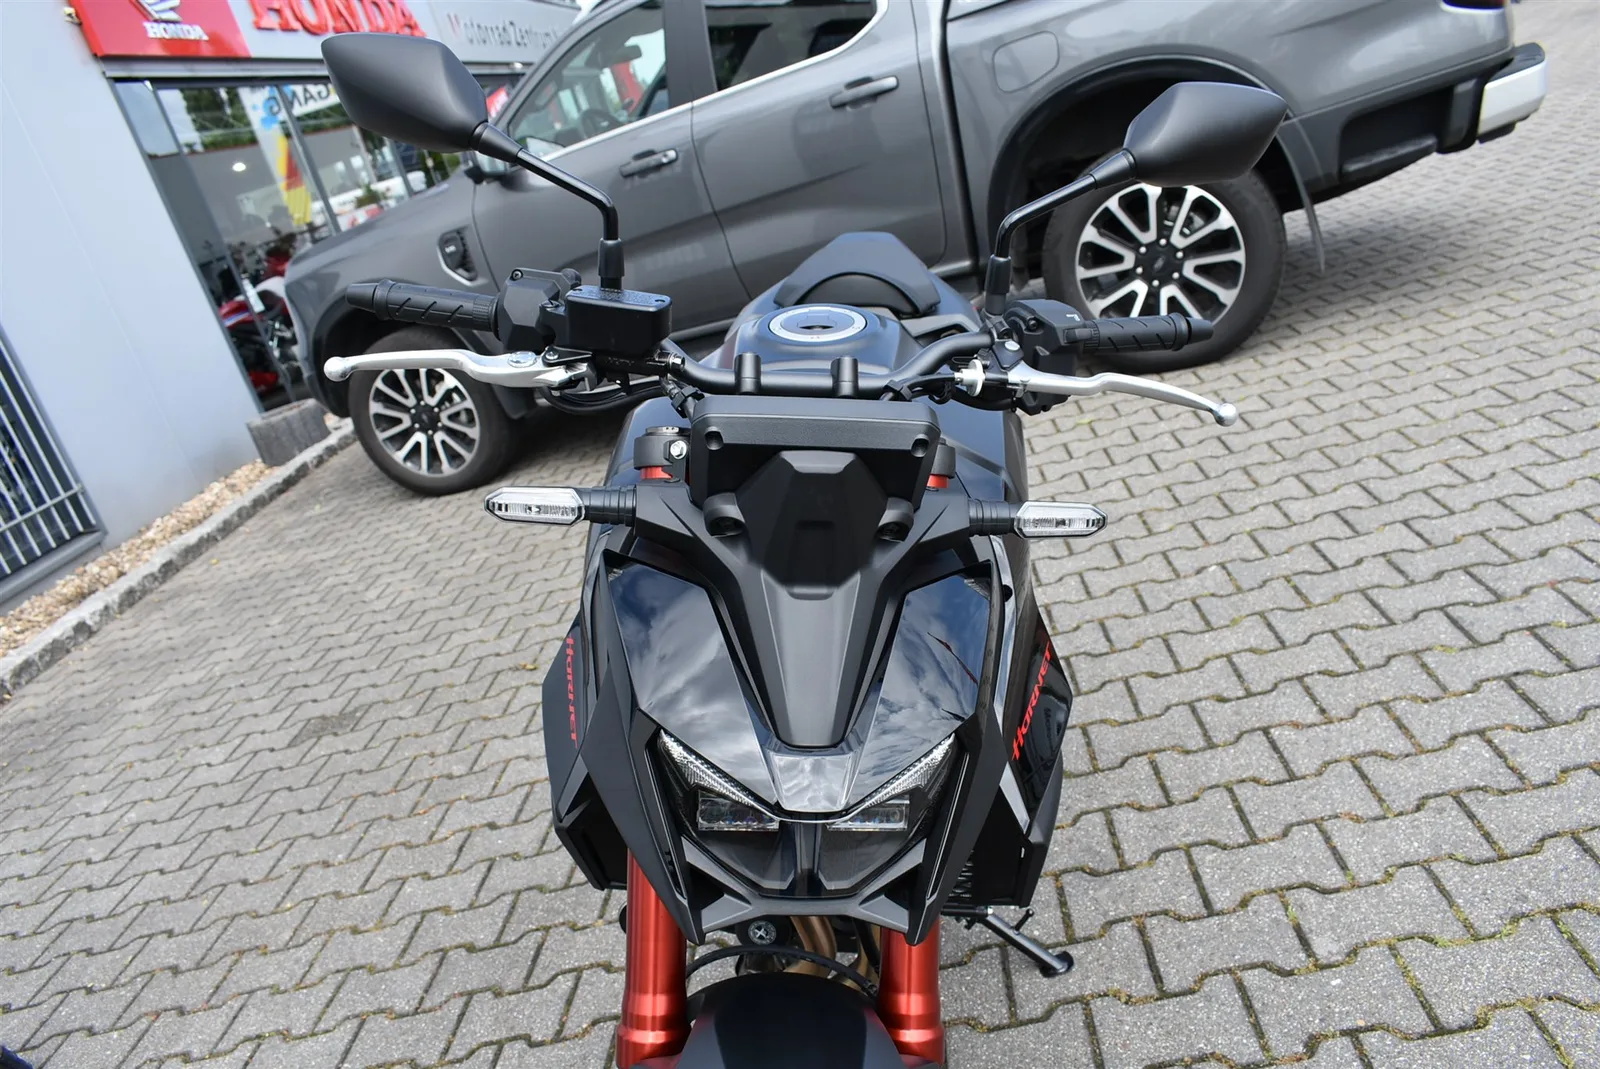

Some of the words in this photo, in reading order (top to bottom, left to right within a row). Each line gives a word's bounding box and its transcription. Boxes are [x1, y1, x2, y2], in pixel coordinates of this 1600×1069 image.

[142, 21, 210, 40] HONDA
[250, 0, 427, 36] HONDA
[1011, 640, 1051, 761] HORNET
